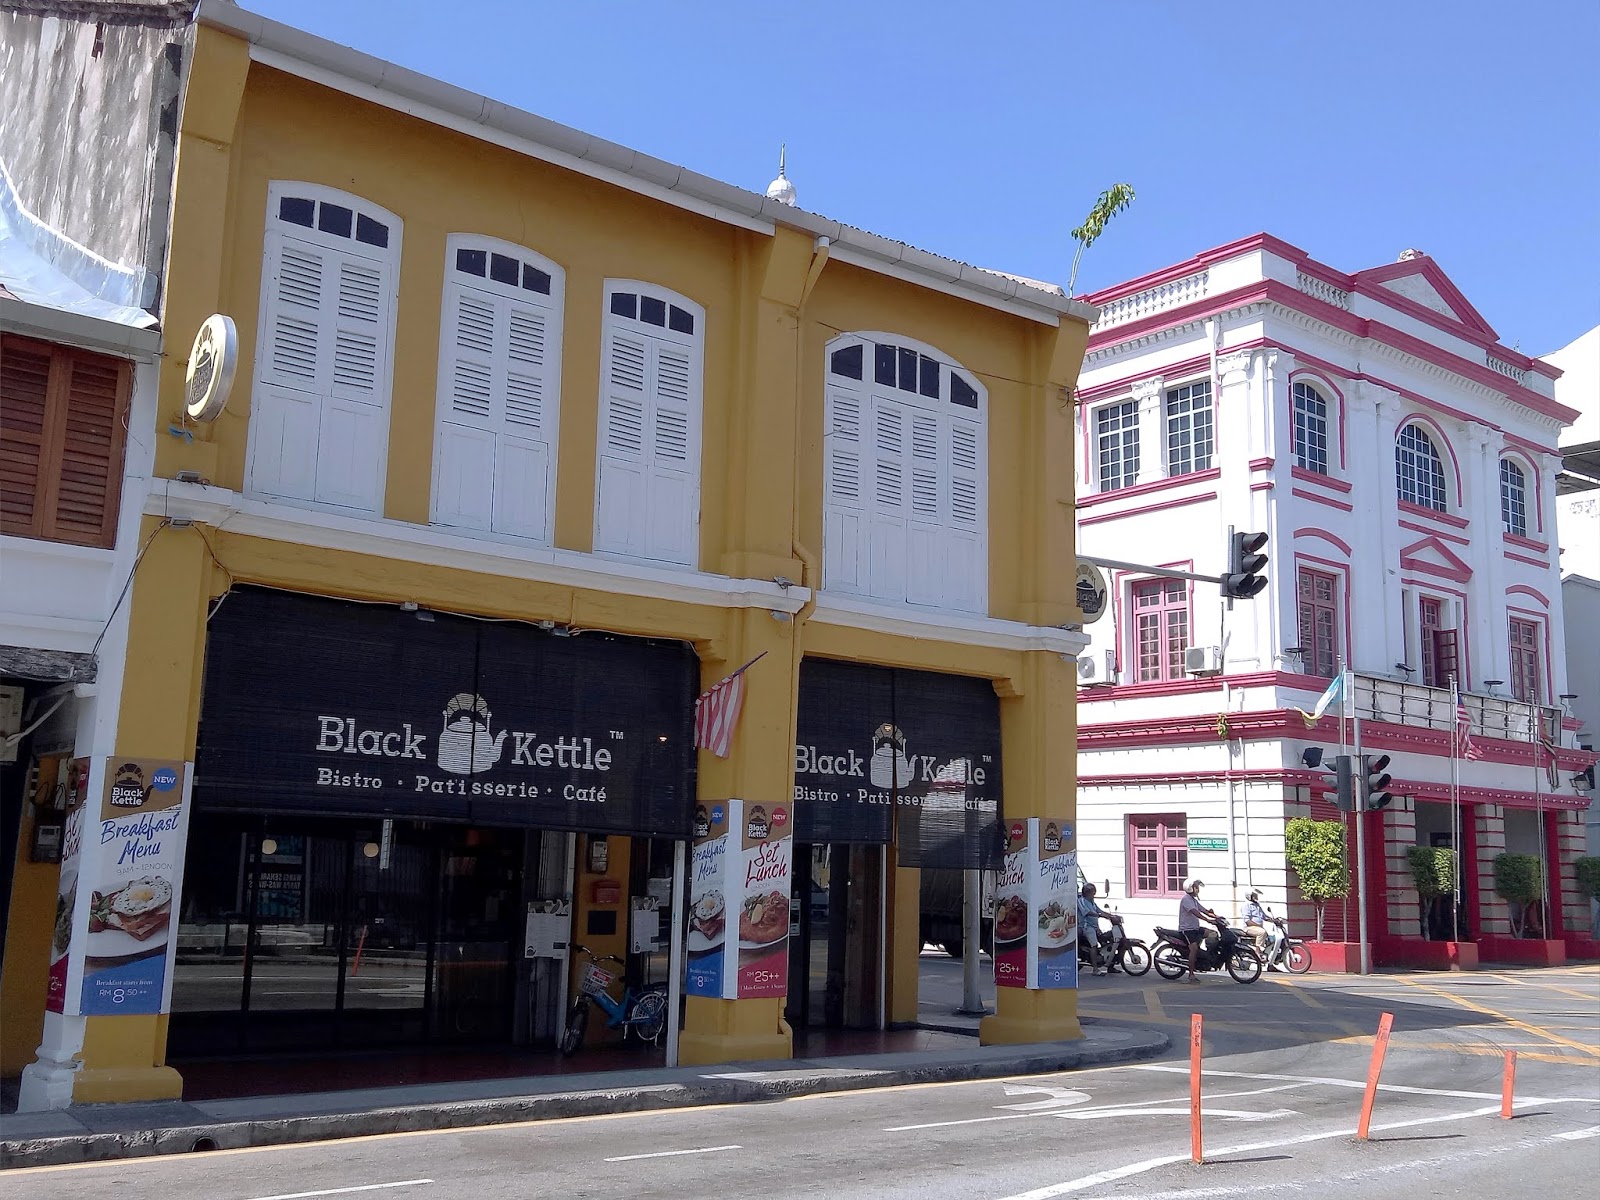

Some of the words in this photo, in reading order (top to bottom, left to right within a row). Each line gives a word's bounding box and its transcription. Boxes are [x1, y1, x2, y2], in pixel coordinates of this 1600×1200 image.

[316, 715, 427, 760] Black
[511, 731, 612, 771] Kettle
[794, 745, 864, 777] Black
[920, 755, 986, 786] Kele
[153, 775, 176, 784] NEW
[316, 767, 383, 789] Bistro
[415, 775, 538, 798] Patisserie
[563, 784, 607, 803] Café
[111, 796, 143, 806] Kettle
[112, 787, 143, 798] Black
[794, 786, 838, 802] Bistro
[100, 811, 181, 845] Breakfast
[748, 824, 768, 832] Black
[748, 830, 768, 839] Kettle
[117, 838, 161, 864] Menu
[692, 839, 727, 864] Breakfast
[753, 840, 781, 868] Set
[141, 862, 173, 871] 12NOON
[697, 861, 718, 881] Menu
[744, 854, 788, 888] Lunch
[1040, 854, 1076, 877] Breakfast
[1050, 873, 1069, 890] Menu
[697, 976, 704, 988] 8
[754, 970, 780, 983] 25++
[112, 988, 125, 1004] 8
